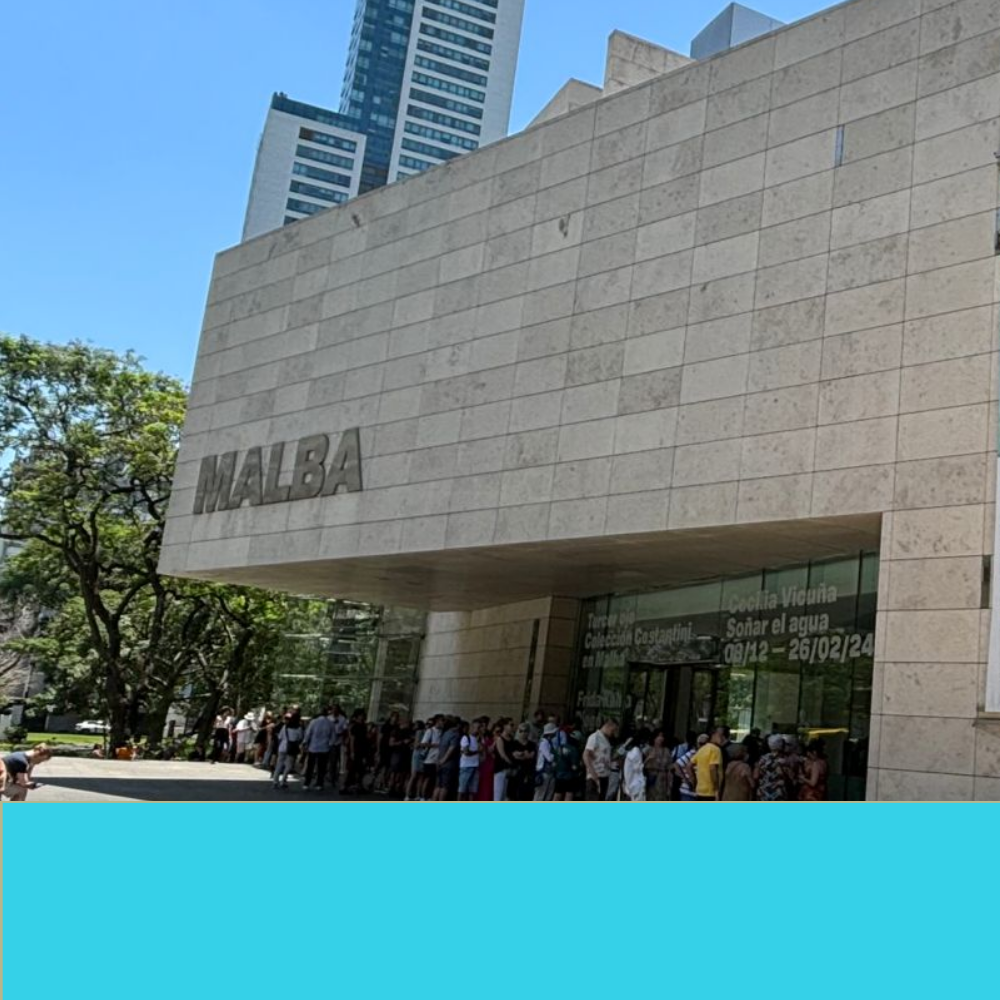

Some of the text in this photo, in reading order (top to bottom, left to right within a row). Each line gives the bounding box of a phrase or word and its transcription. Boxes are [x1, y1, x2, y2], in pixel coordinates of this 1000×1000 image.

[193, 427, 364, 515] MALBA
[729, 582, 838, 614] Cecilia Vicuña
[726, 613, 830, 639] Soñar el agua
[724, 639, 769, 667] 08/12
[788, 633, 874, 665] 26/02/24
